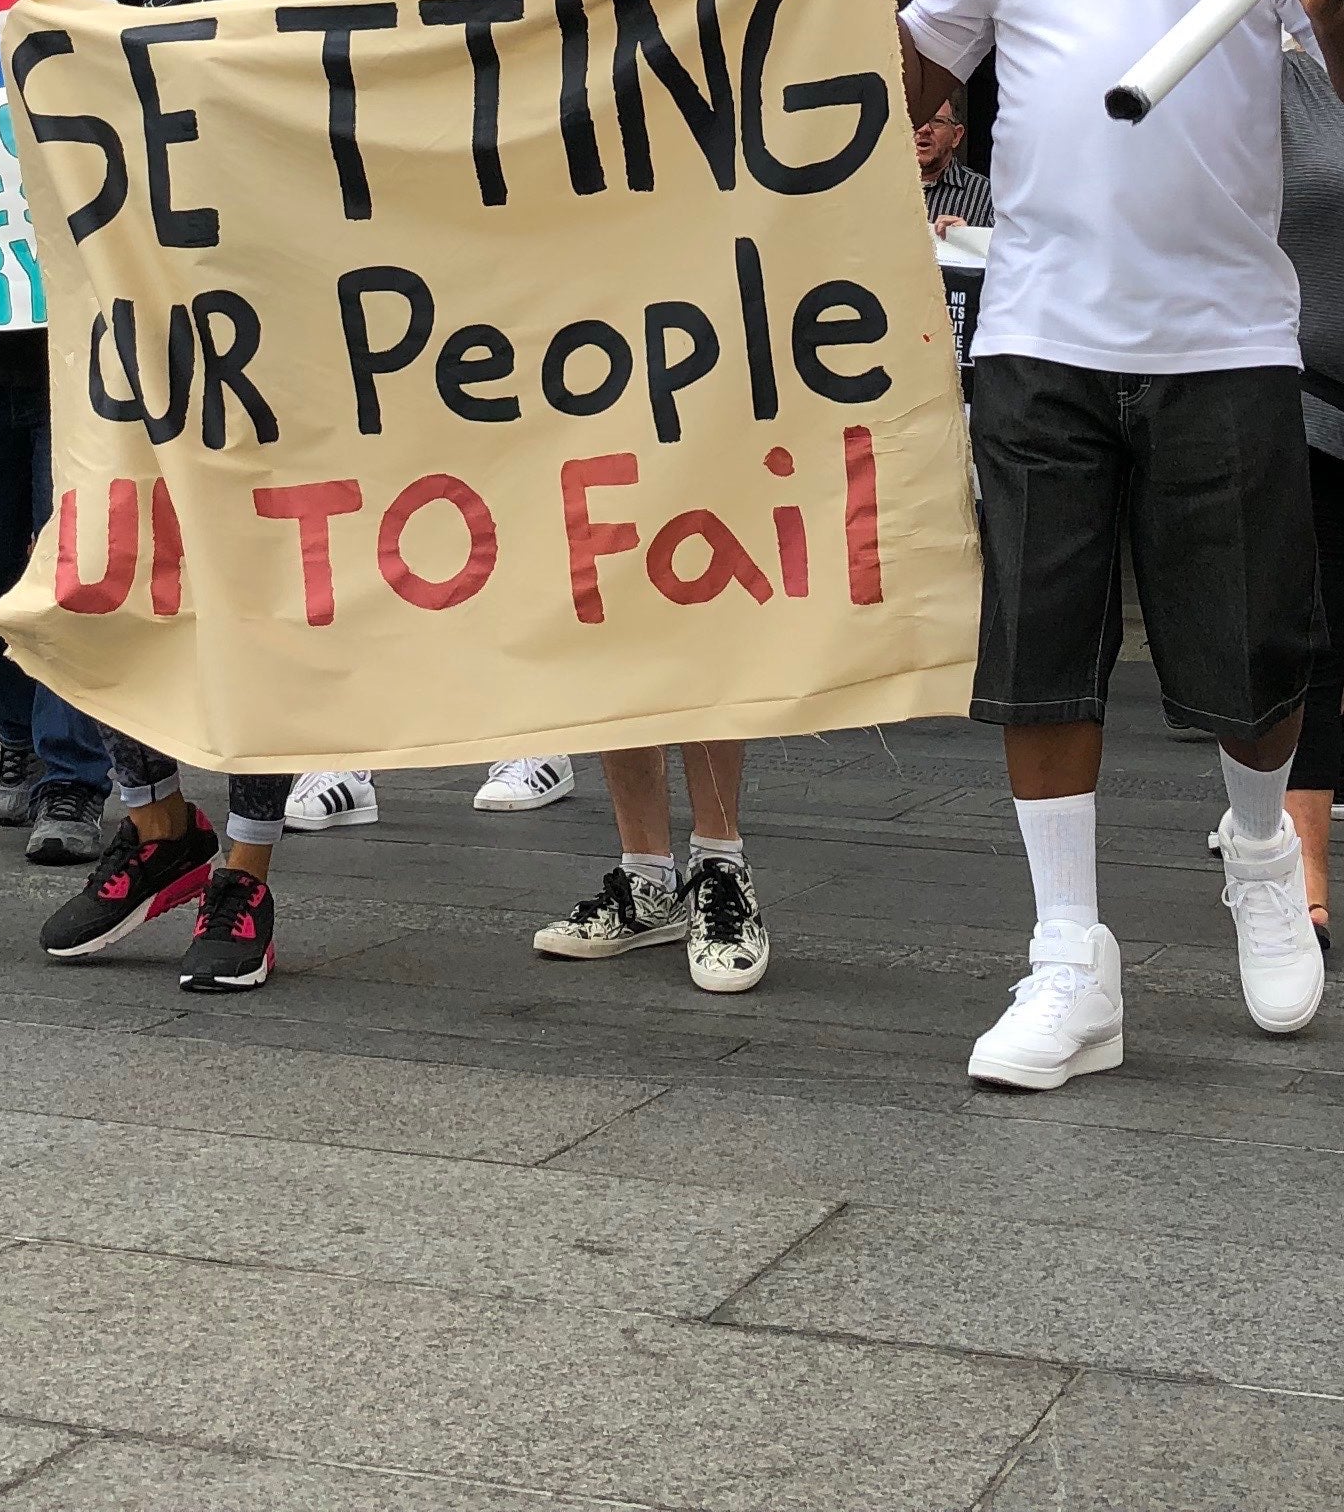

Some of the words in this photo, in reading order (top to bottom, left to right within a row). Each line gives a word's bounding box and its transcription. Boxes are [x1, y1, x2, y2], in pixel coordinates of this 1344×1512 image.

[87, 289, 280, 450] OUR
[337, 235, 892, 444] People
[252, 472, 498, 627] TO
[560, 424, 884, 624] Fail
